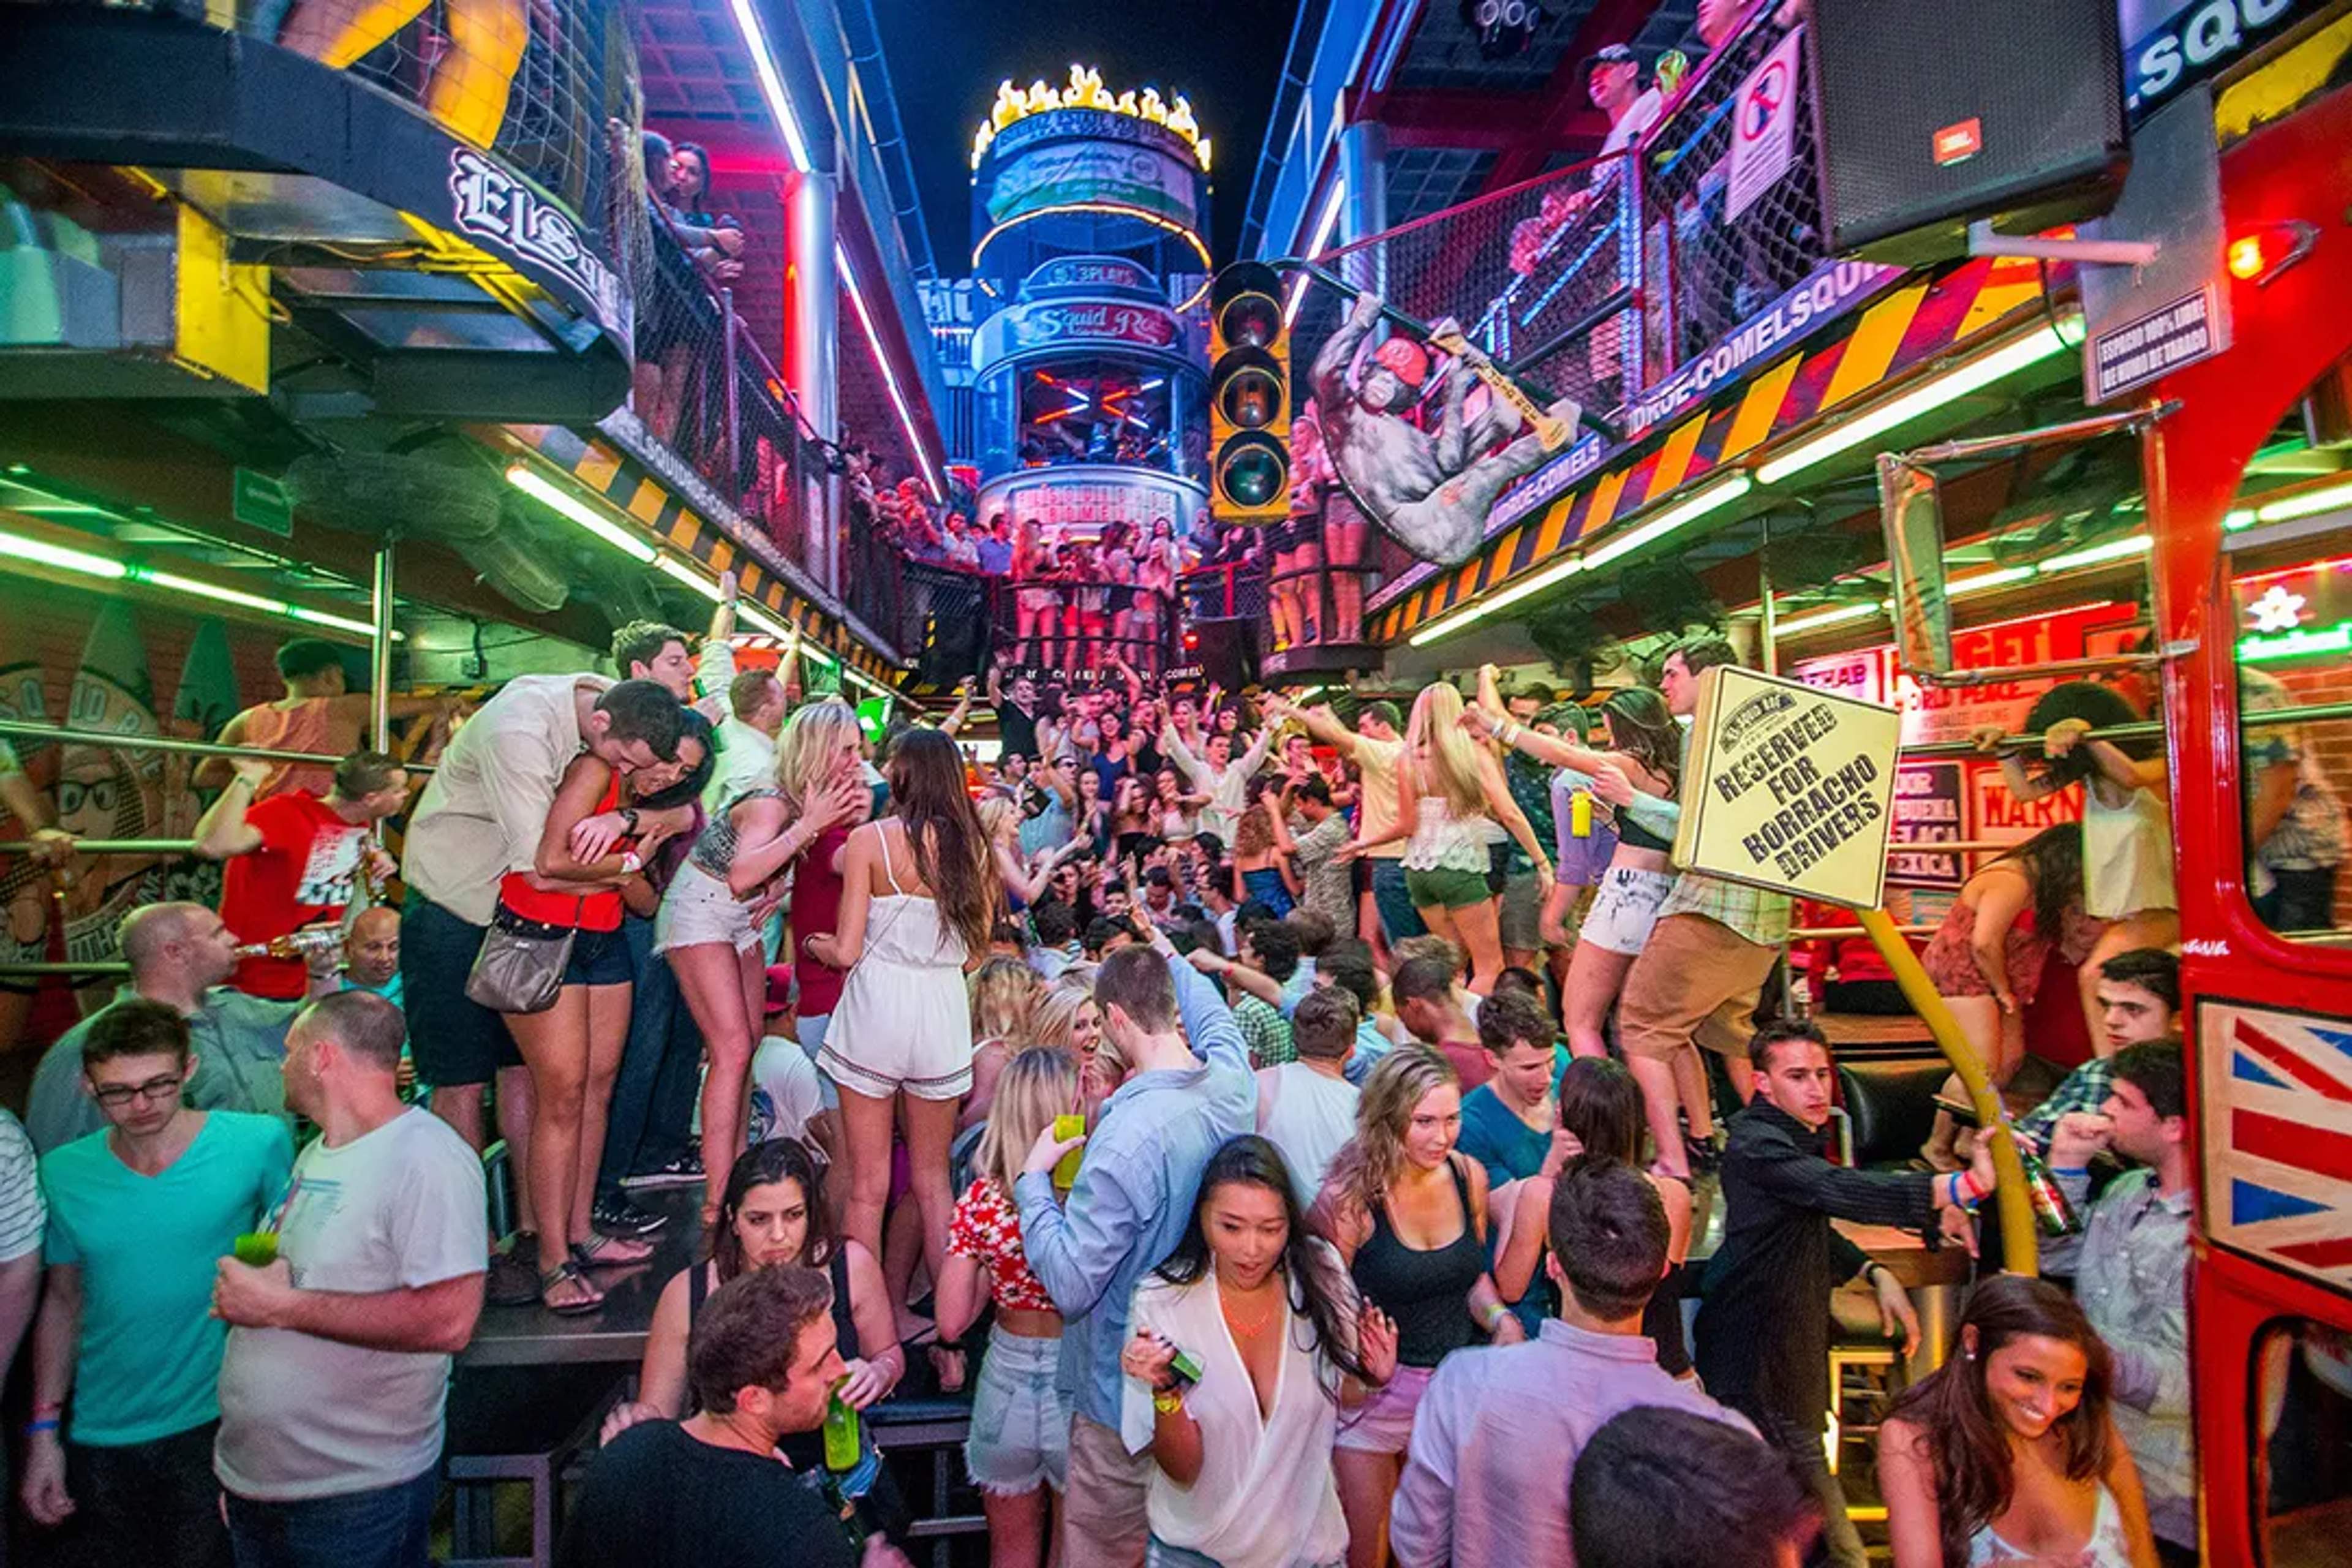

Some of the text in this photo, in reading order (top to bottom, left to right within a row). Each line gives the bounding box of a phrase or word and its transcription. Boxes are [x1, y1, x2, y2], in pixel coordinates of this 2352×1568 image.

[1714, 703, 1838, 804] RESERVED
[1766, 755, 1822, 805] FOR
[1742, 753, 1879, 864] BORRACHO
[1774, 791, 1882, 881] DRIVERS
